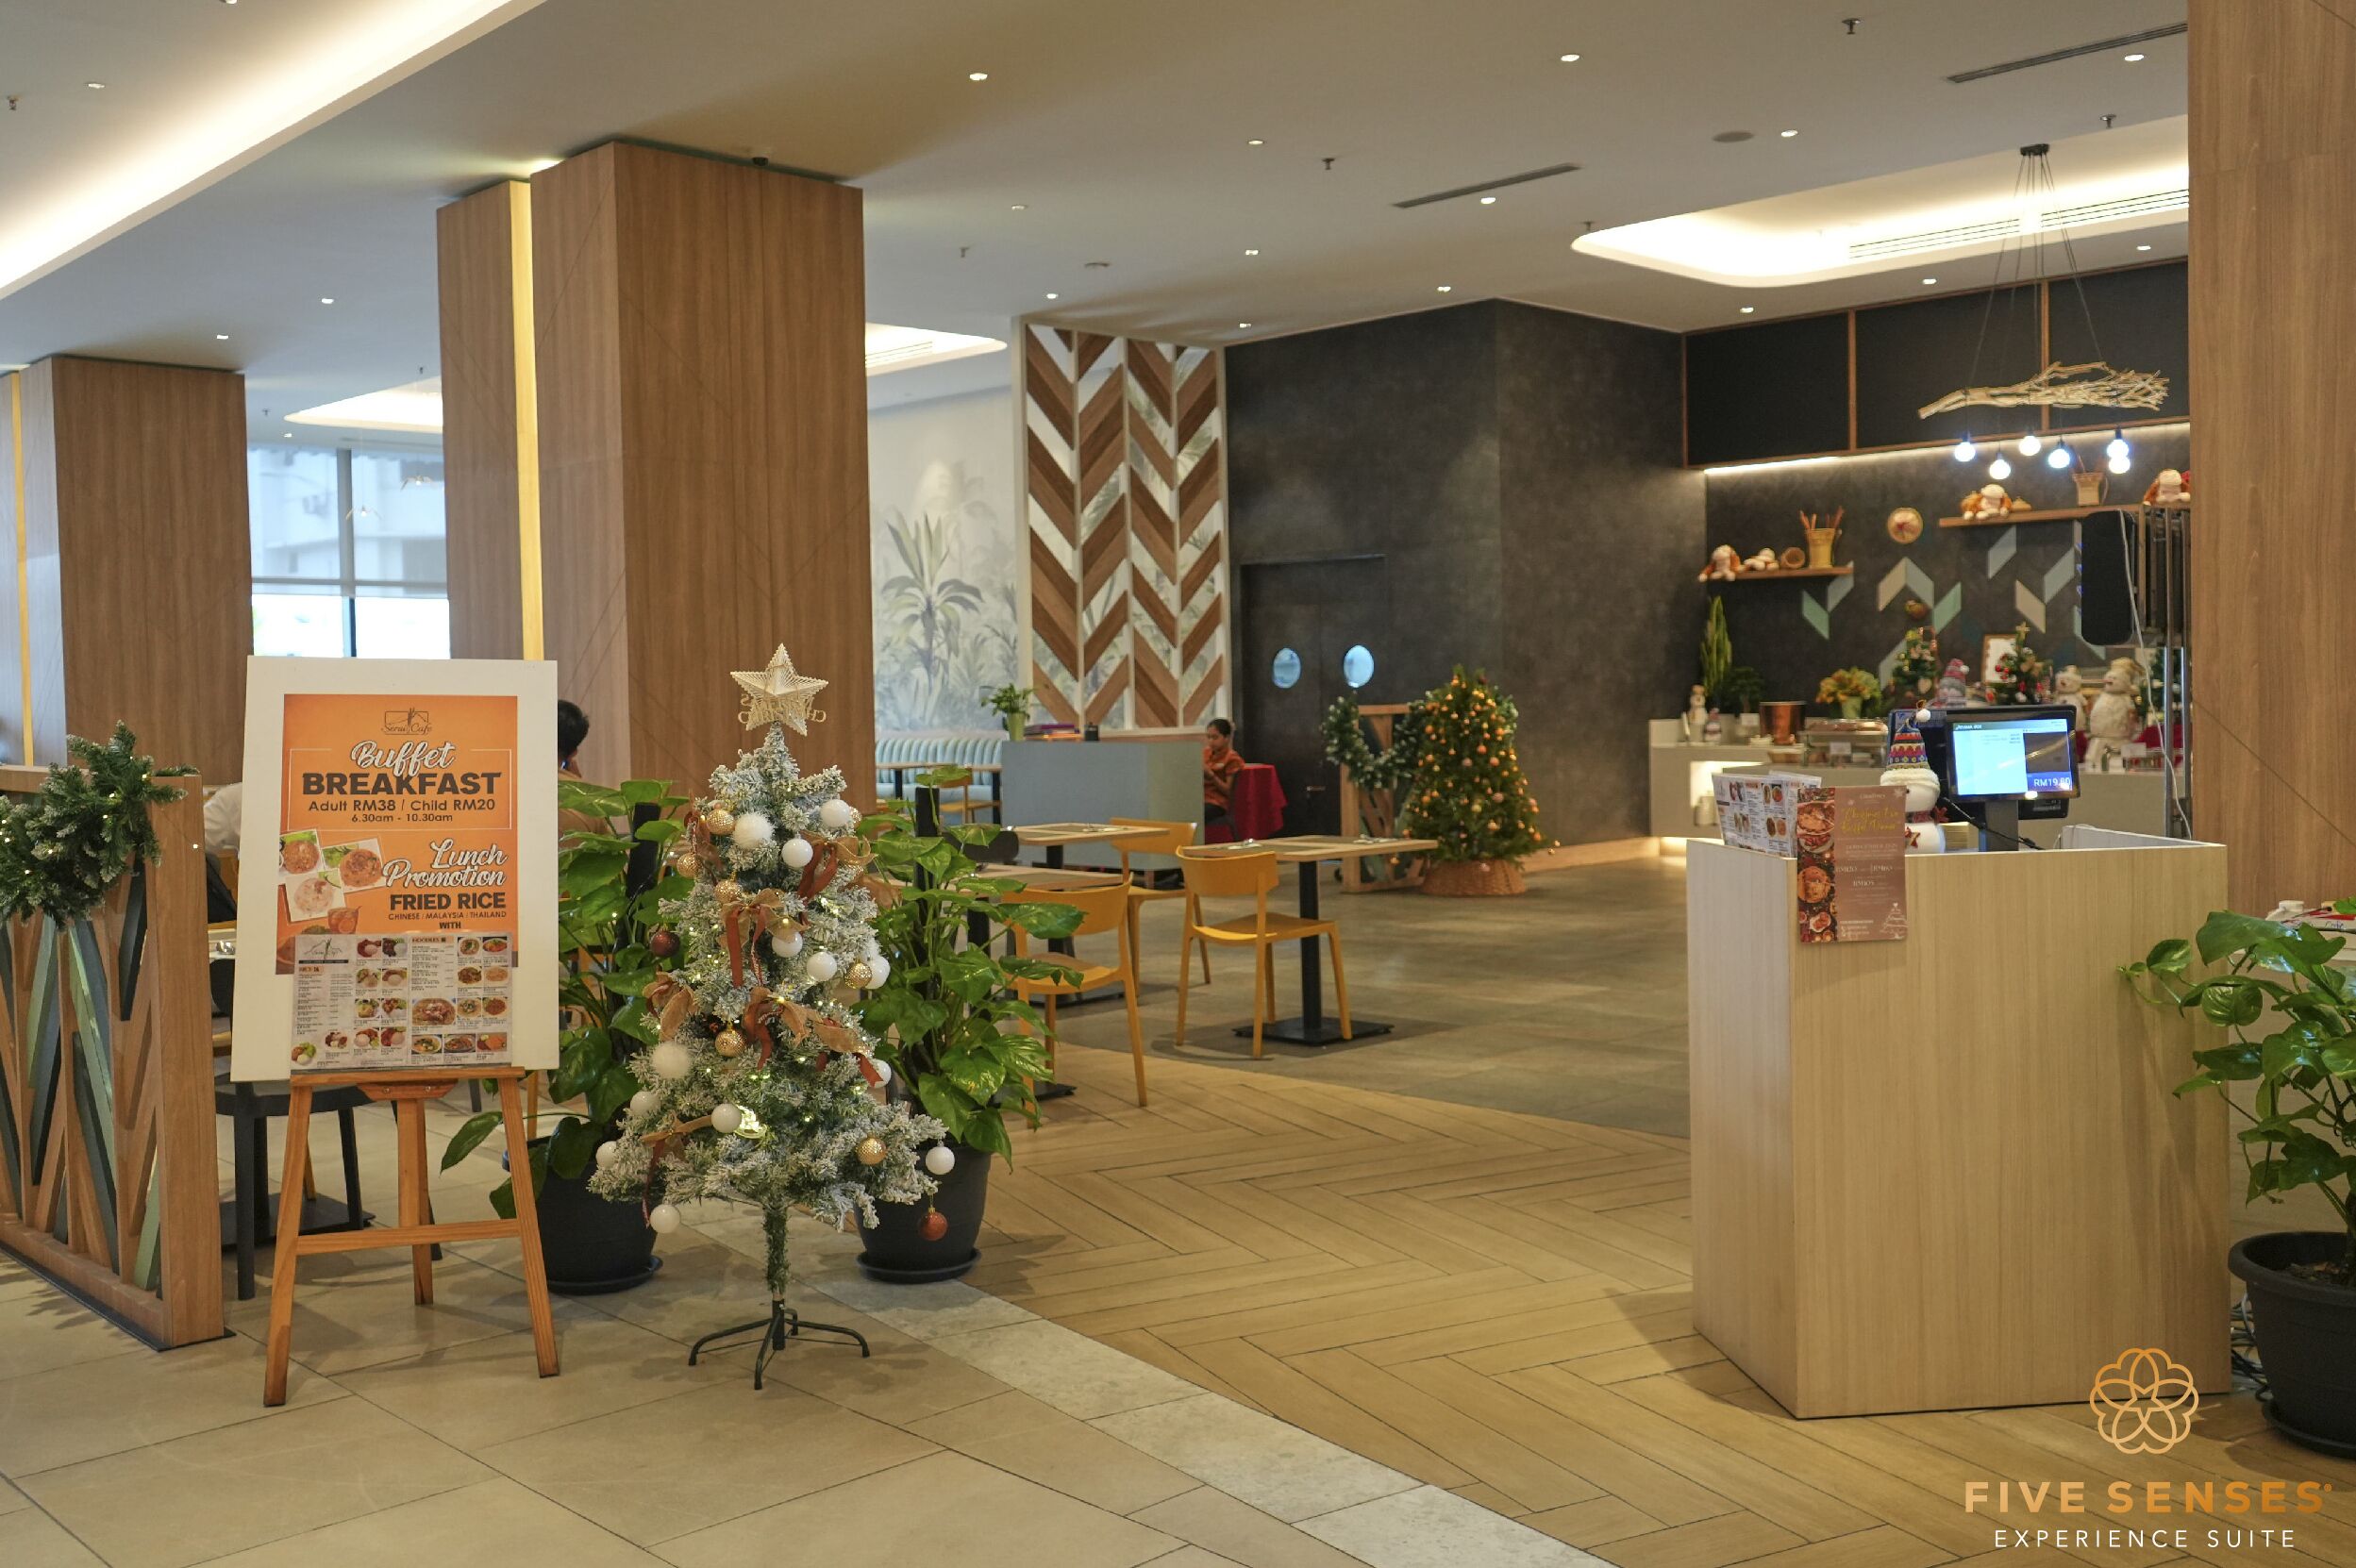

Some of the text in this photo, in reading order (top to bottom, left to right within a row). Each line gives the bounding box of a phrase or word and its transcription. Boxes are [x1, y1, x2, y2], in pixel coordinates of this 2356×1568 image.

[351, 740, 455, 776] Buffet
[302, 772, 502, 795] BREAKFAST
[309, 800, 347, 811] Adult
[353, 799, 396, 811] RM38
[410, 799, 447, 811] Child
[453, 798, 495, 810] RM20
[351, 813, 393, 823] 6.30am
[406, 813, 453, 822] 10.30am
[430, 838, 508, 869] Lunch
[382, 859, 507, 888] Promotion
[390, 892, 507, 910] FRIED RICE
